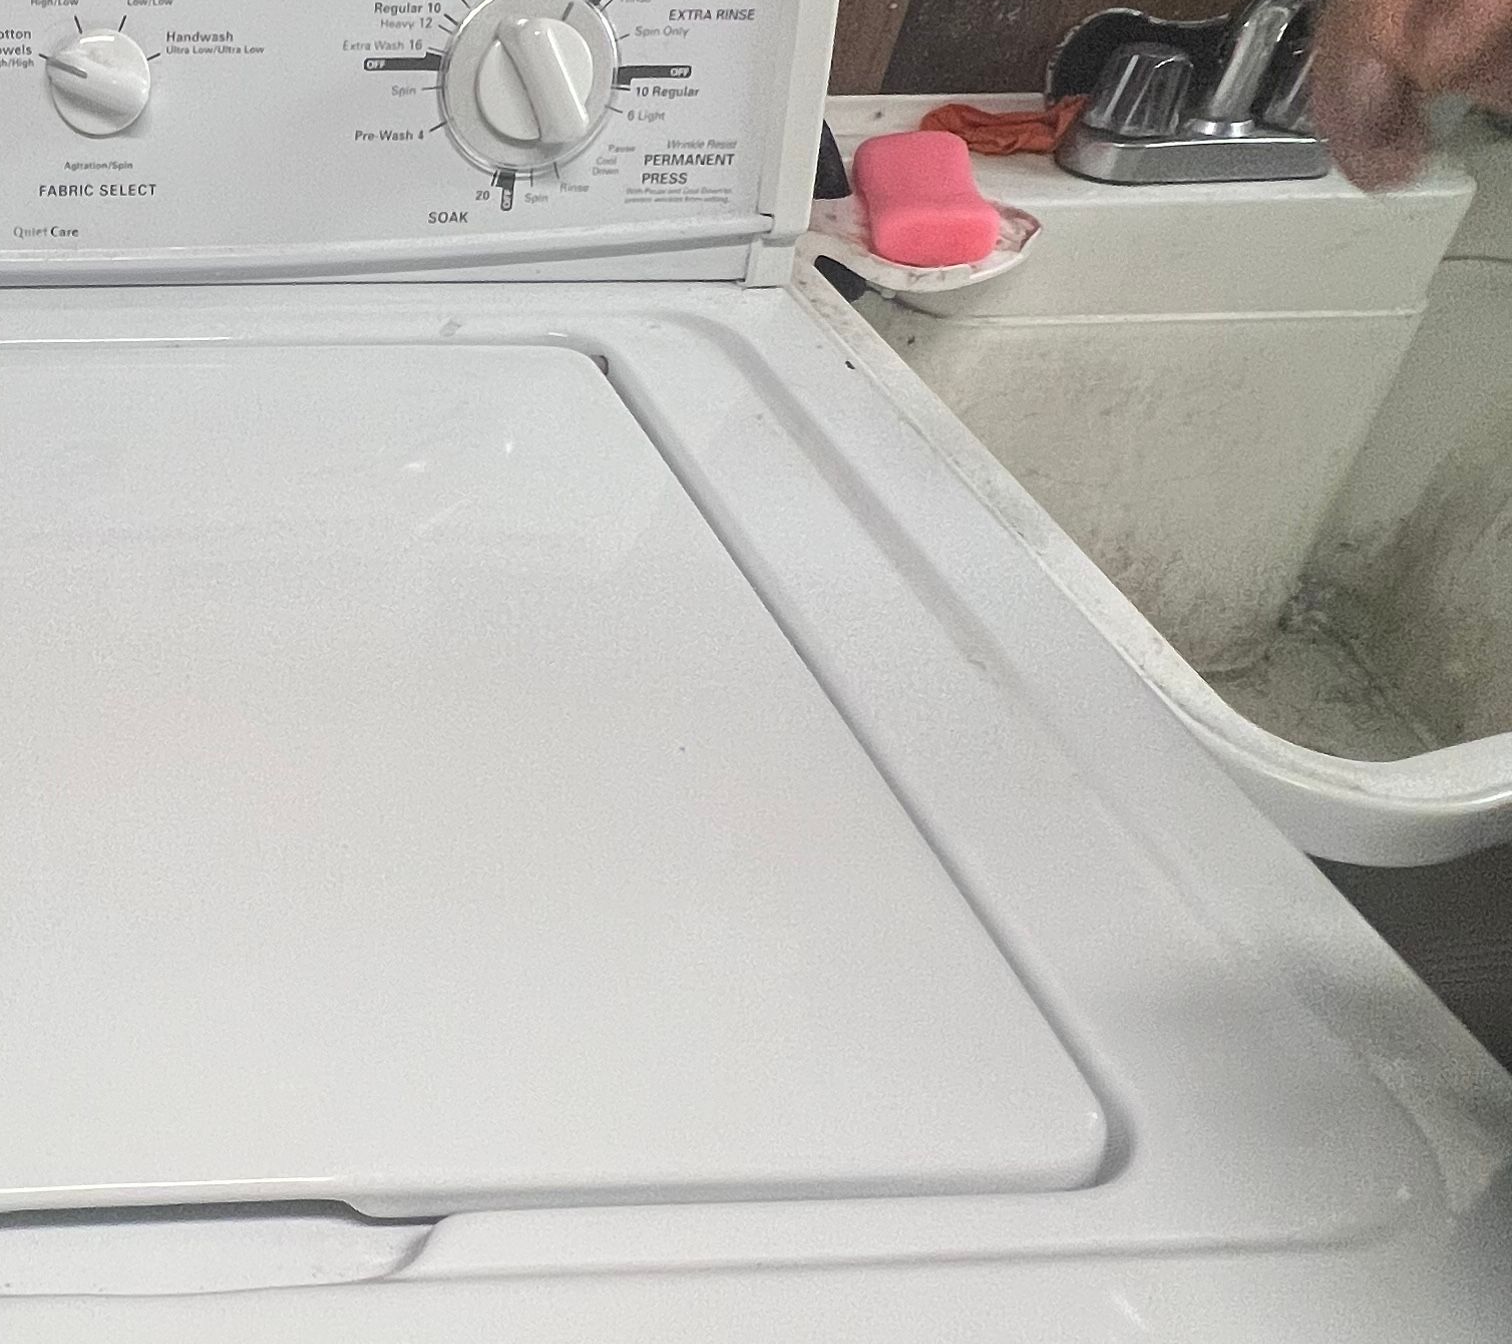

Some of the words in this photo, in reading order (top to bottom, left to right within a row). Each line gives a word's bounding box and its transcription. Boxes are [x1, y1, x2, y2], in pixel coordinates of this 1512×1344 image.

[374, 2, 423, 16] Regular
[427, 2, 441, 13] 10
[668, 9, 712, 21] EXTRA
[716, 8, 756, 21] RINSE
[381, 19, 415, 30] Heavy
[419, 17, 433, 29] 12
[166, 31, 234, 43] Handwash
[634, 26, 661, 38] Spin
[663, 25, 690, 38] Only
[166, 46, 189, 55] Ultra
[192, 45, 241, 56] Low/Ultra
[245, 45, 265, 55] Low
[342, 40, 372, 51] Extra
[375, 40, 405, 51] Wash
[409, 39, 423, 50] 16
[366, 60, 386, 70] OFF
[670, 67, 690, 77] OFF
[391, 85, 417, 97] Spin
[636, 87, 649, 97] 10
[652, 86, 700, 99] Regular
[627, 110, 635, 121] 6
[638, 112, 665, 122] Light
[355, 130, 414, 141] Pre-Wash
[417, 130, 425, 140] 4
[643, 153, 735, 166] PERMANENT
[64, 161, 134, 171] Agitation/Spin
[641, 172, 688, 185] PRESS
[39, 185, 94, 197] FABRIC
[99, 184, 157, 197] SELECT
[559, 183, 590, 194] Rinse
[475, 190, 490, 201] 20
[524, 192, 549, 205] Spin
[428, 211, 469, 224] SOAK
[13, 226, 49, 239] Quiet
[50, 225, 79, 238] Care
